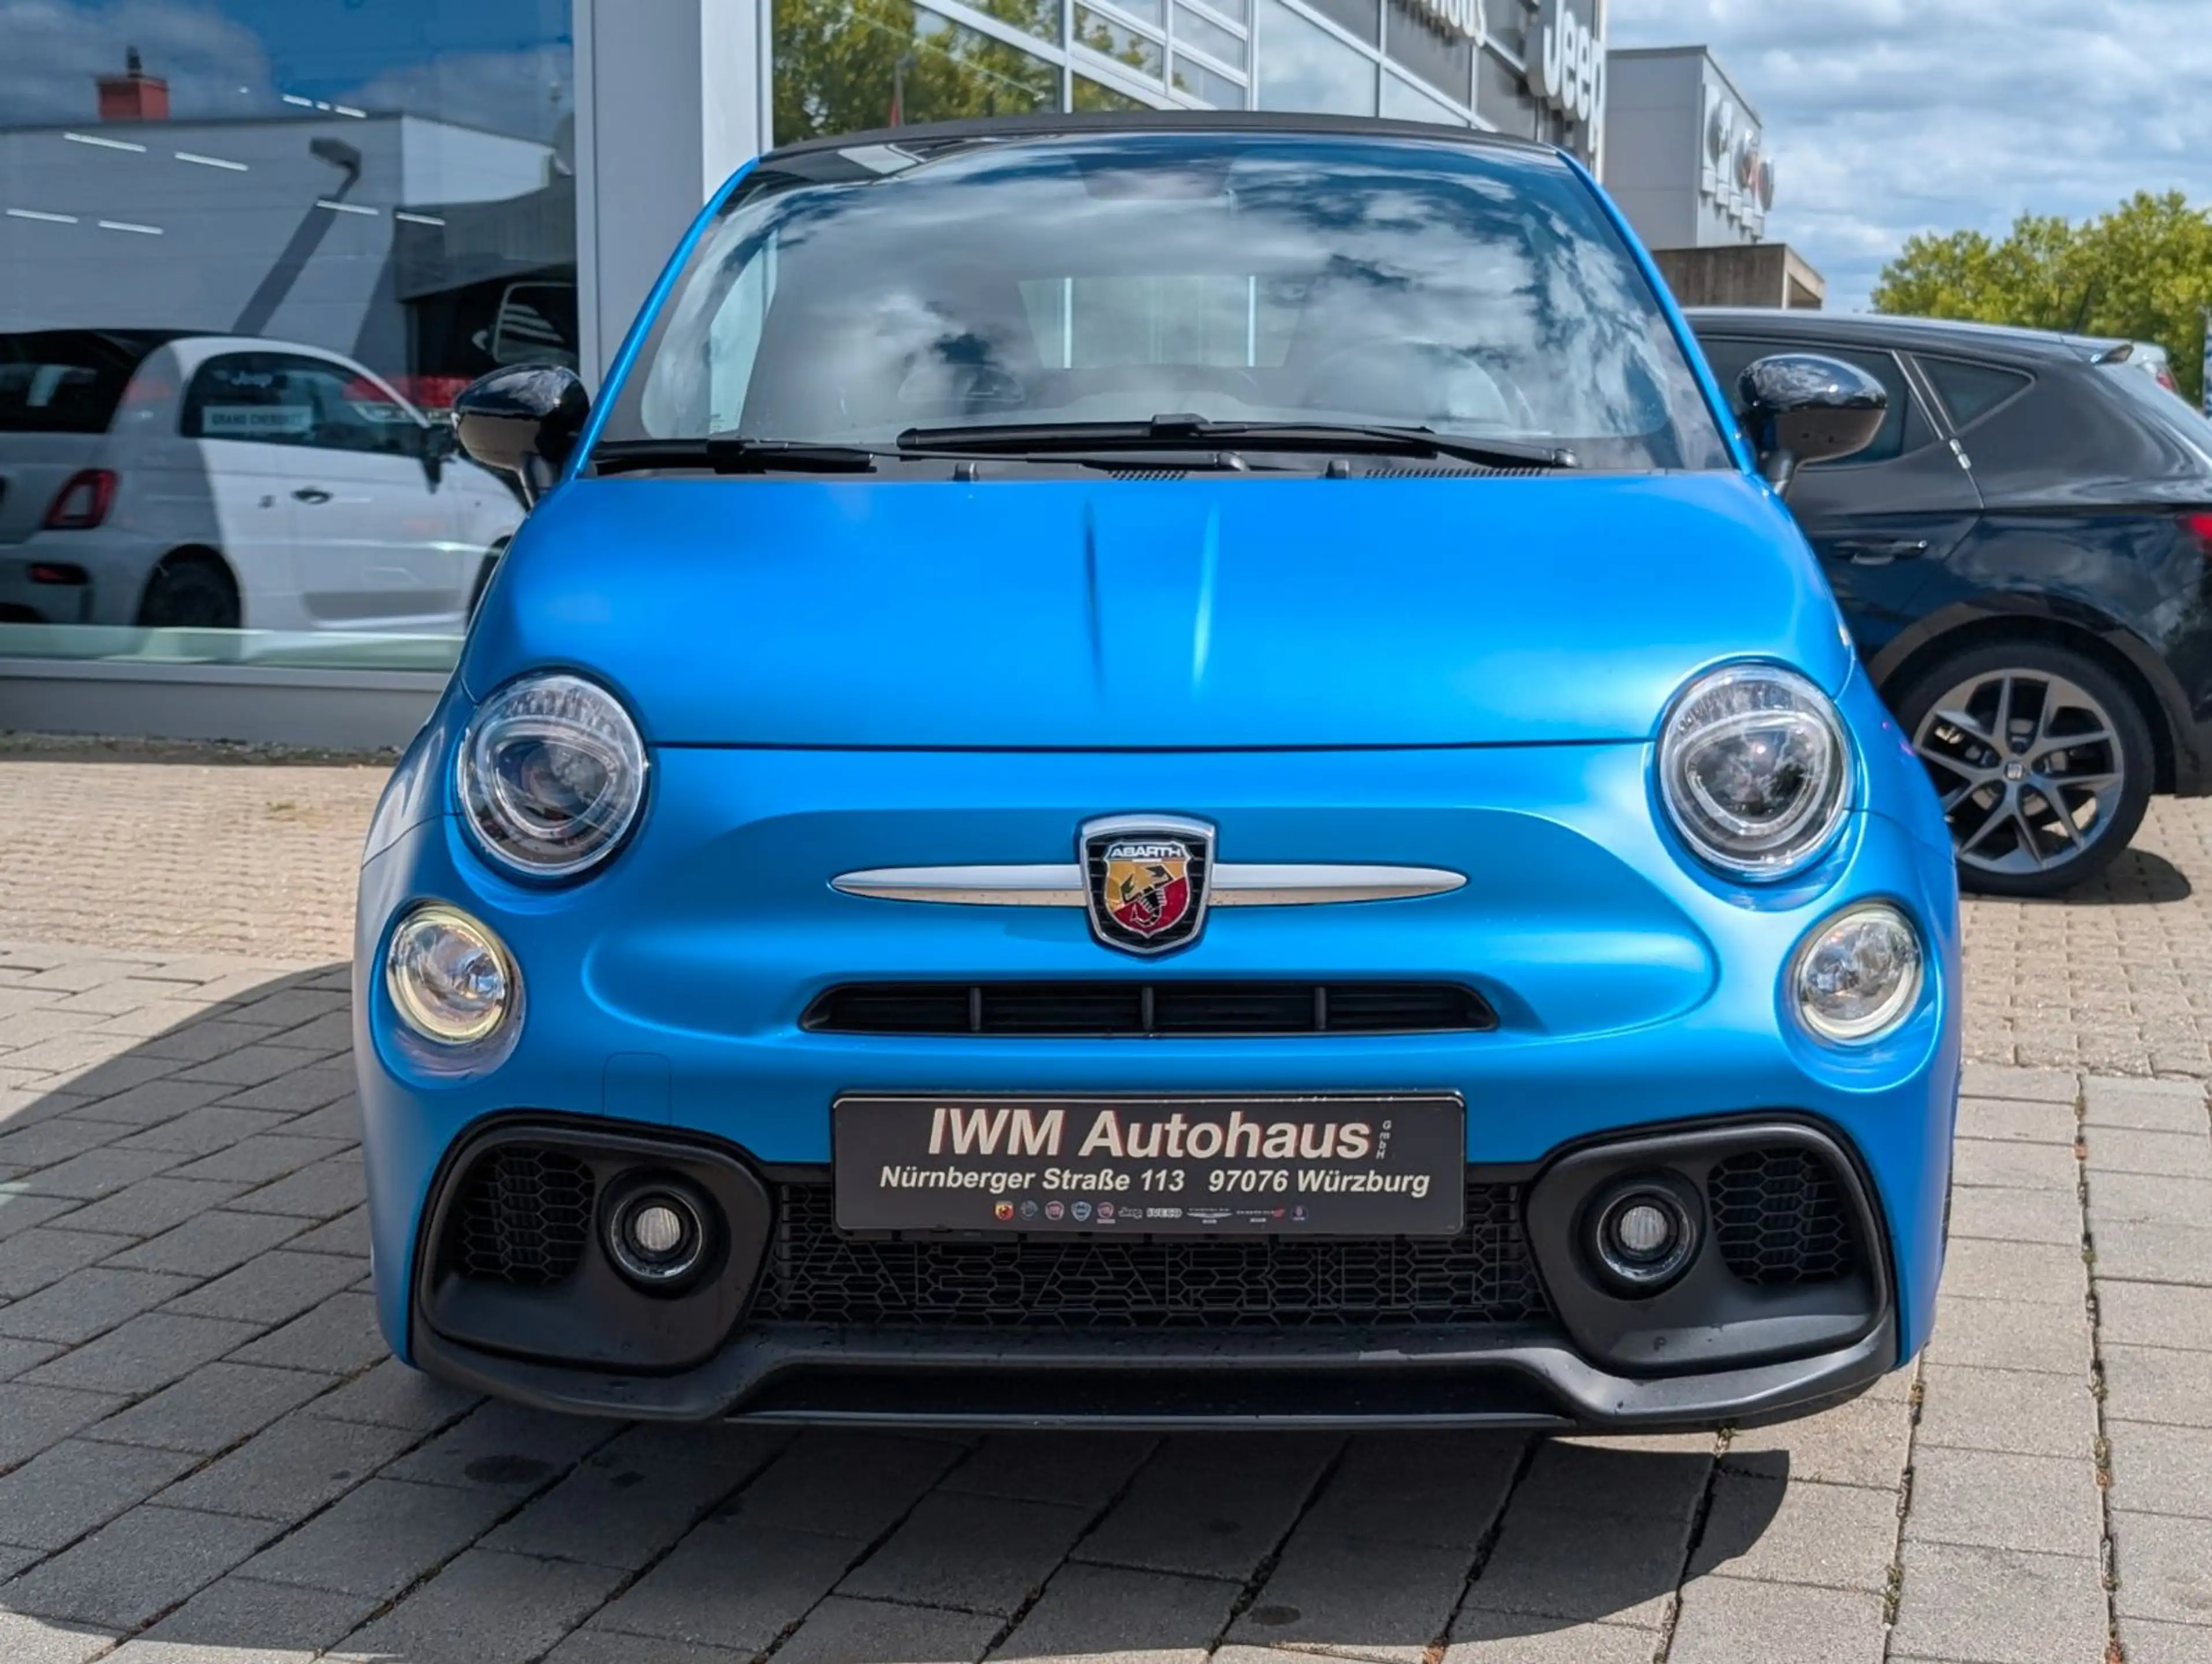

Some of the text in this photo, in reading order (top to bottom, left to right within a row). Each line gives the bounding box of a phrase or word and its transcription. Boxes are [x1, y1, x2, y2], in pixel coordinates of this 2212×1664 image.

[1111, 846, 1181, 857] ABARTH
[928, 1108, 1371, 1159] IWM Autohaus
[879, 1165, 1430, 1198] Nürnberger Straße 113 97076 Würzburg
